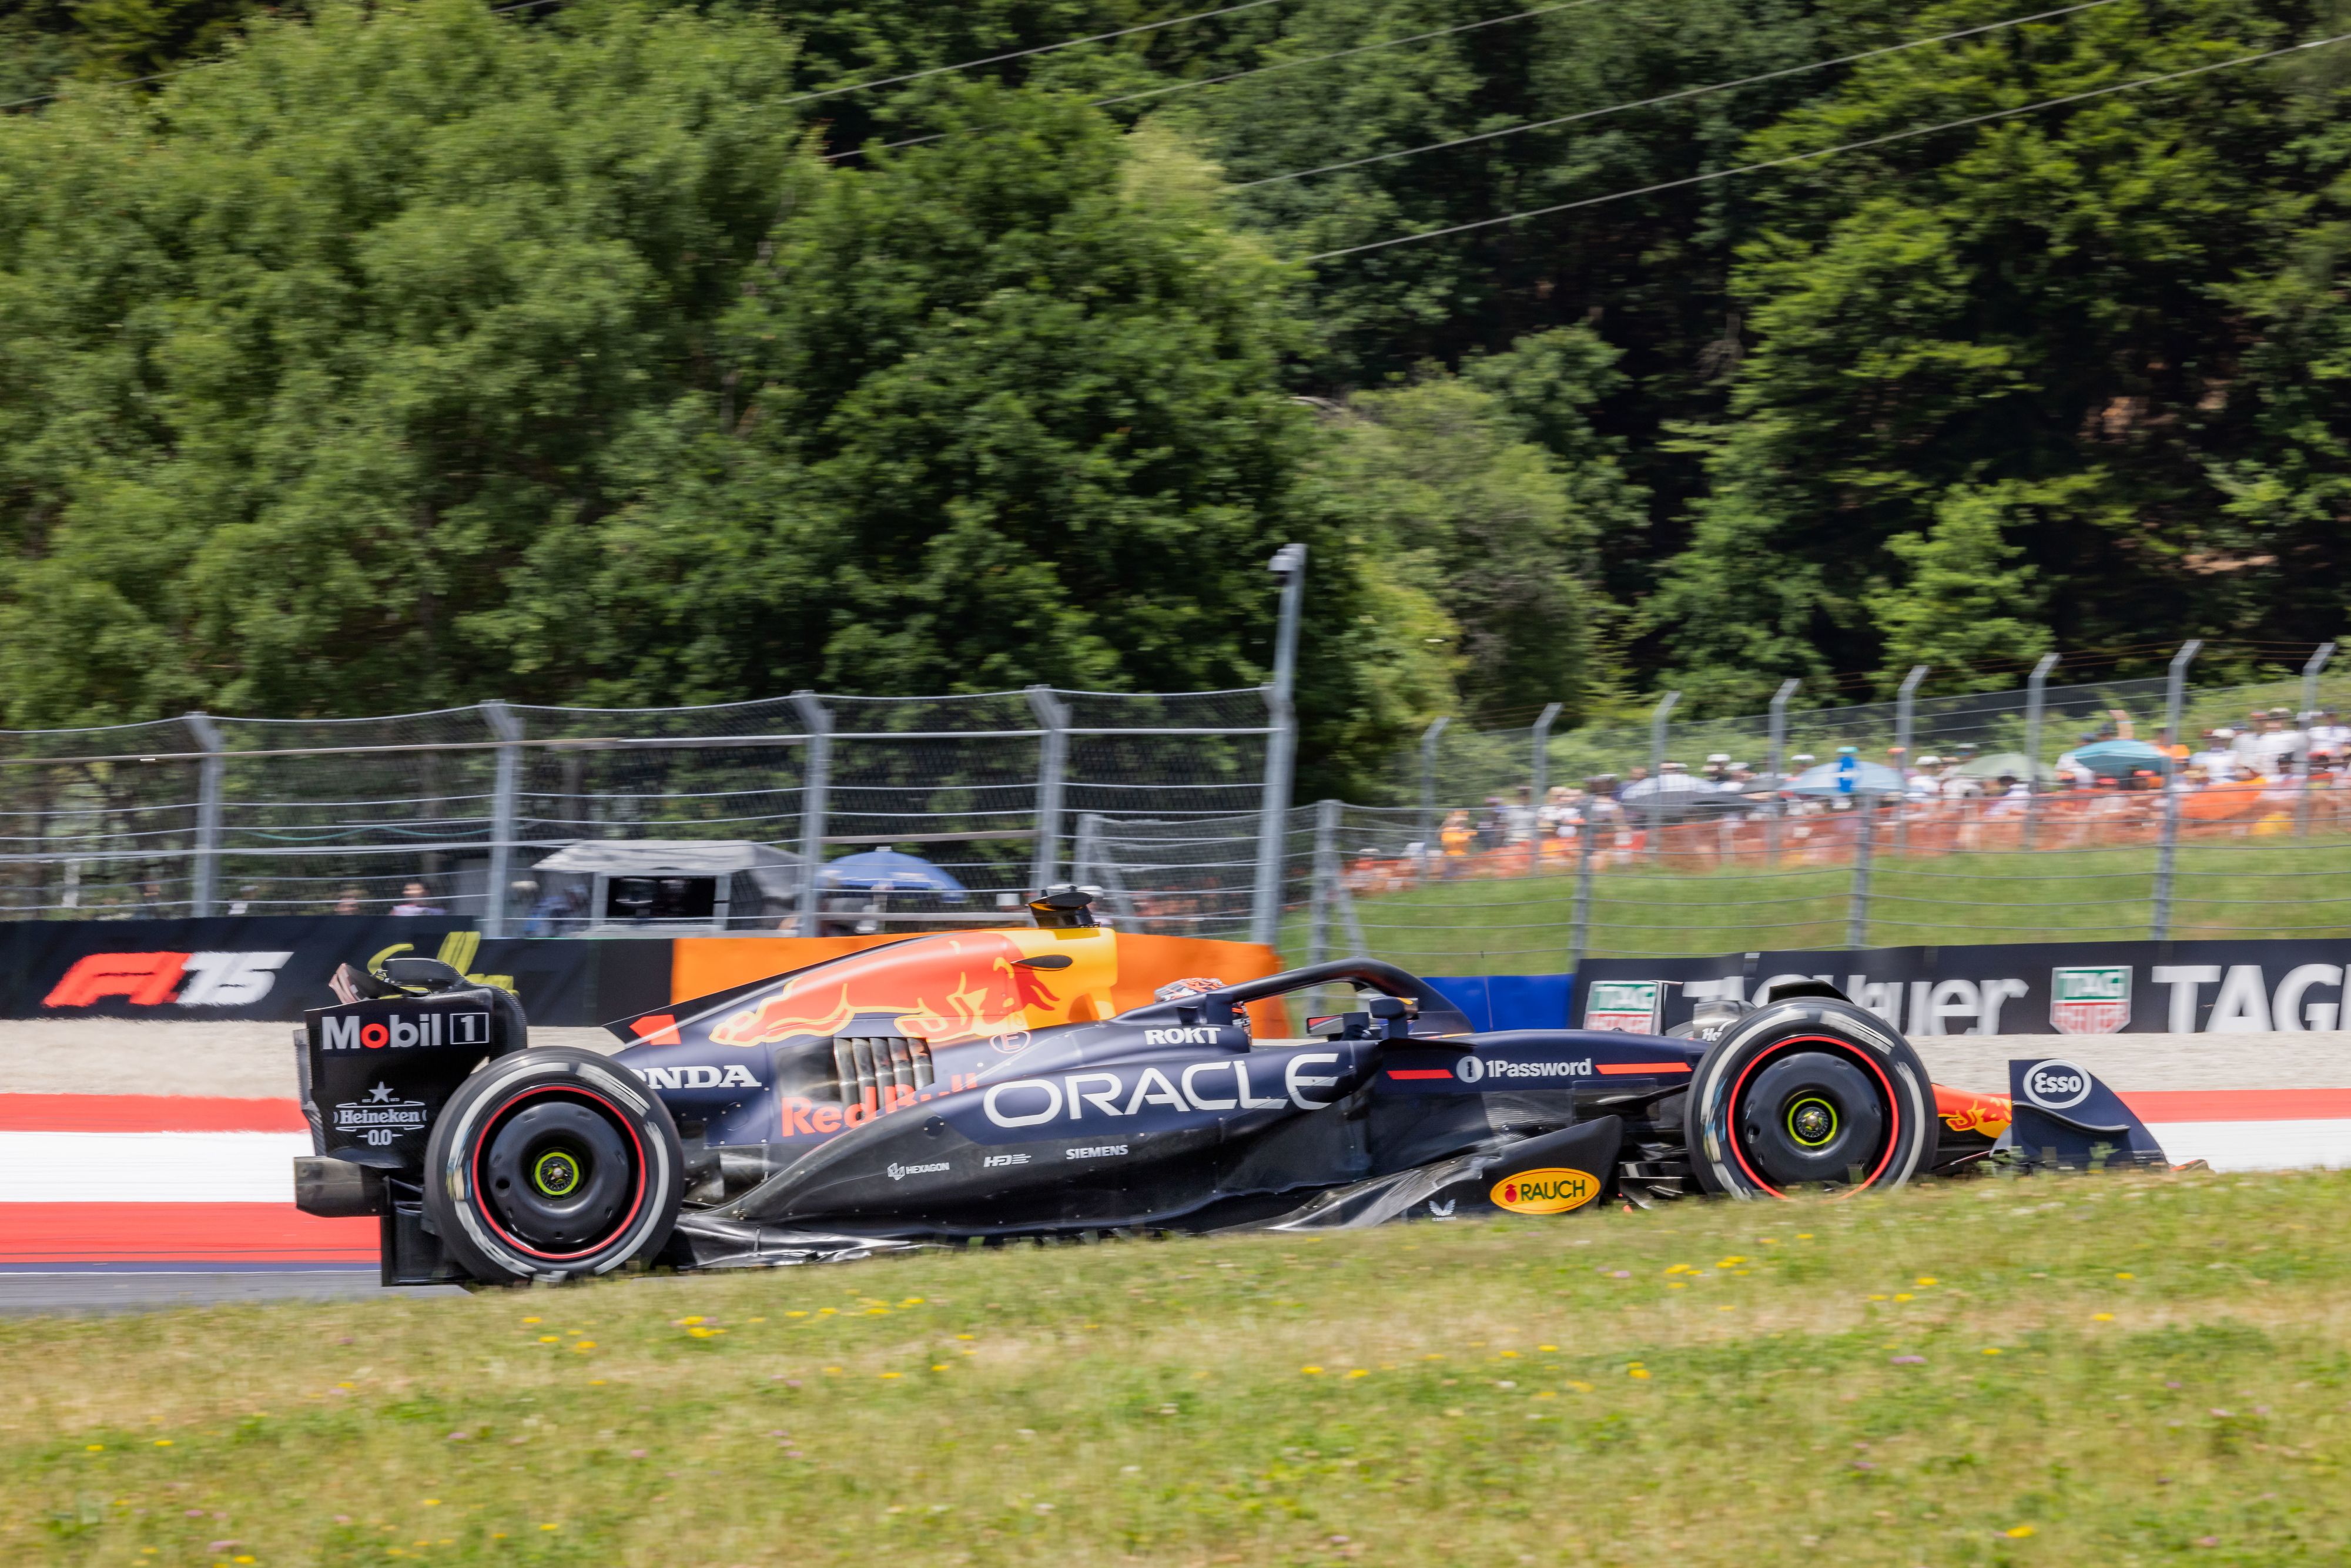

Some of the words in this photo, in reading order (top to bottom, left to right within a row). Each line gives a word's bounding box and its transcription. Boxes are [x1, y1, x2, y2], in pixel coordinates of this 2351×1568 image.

[2058, 973, 2125, 997] TAG
[2152, 964, 2343, 1033] TAG
[321, 1014, 441, 1050] Mobil
[1144, 1027, 1221, 1045] ROKT
[1486, 1058, 1592, 1078] 1Password
[983, 1053, 1339, 1128] ORACLE
[2034, 1072, 2082, 1093] Esso
[339, 1109, 421, 1124] Heineken
[781, 1086, 877, 1137] Red
[367, 1129, 393, 1145] 0.0
[1066, 1145, 1128, 1160] SIEMENS
[905, 1162, 950, 1174] HEXAGON
[1521, 1179, 1586, 1201] RAUCH
